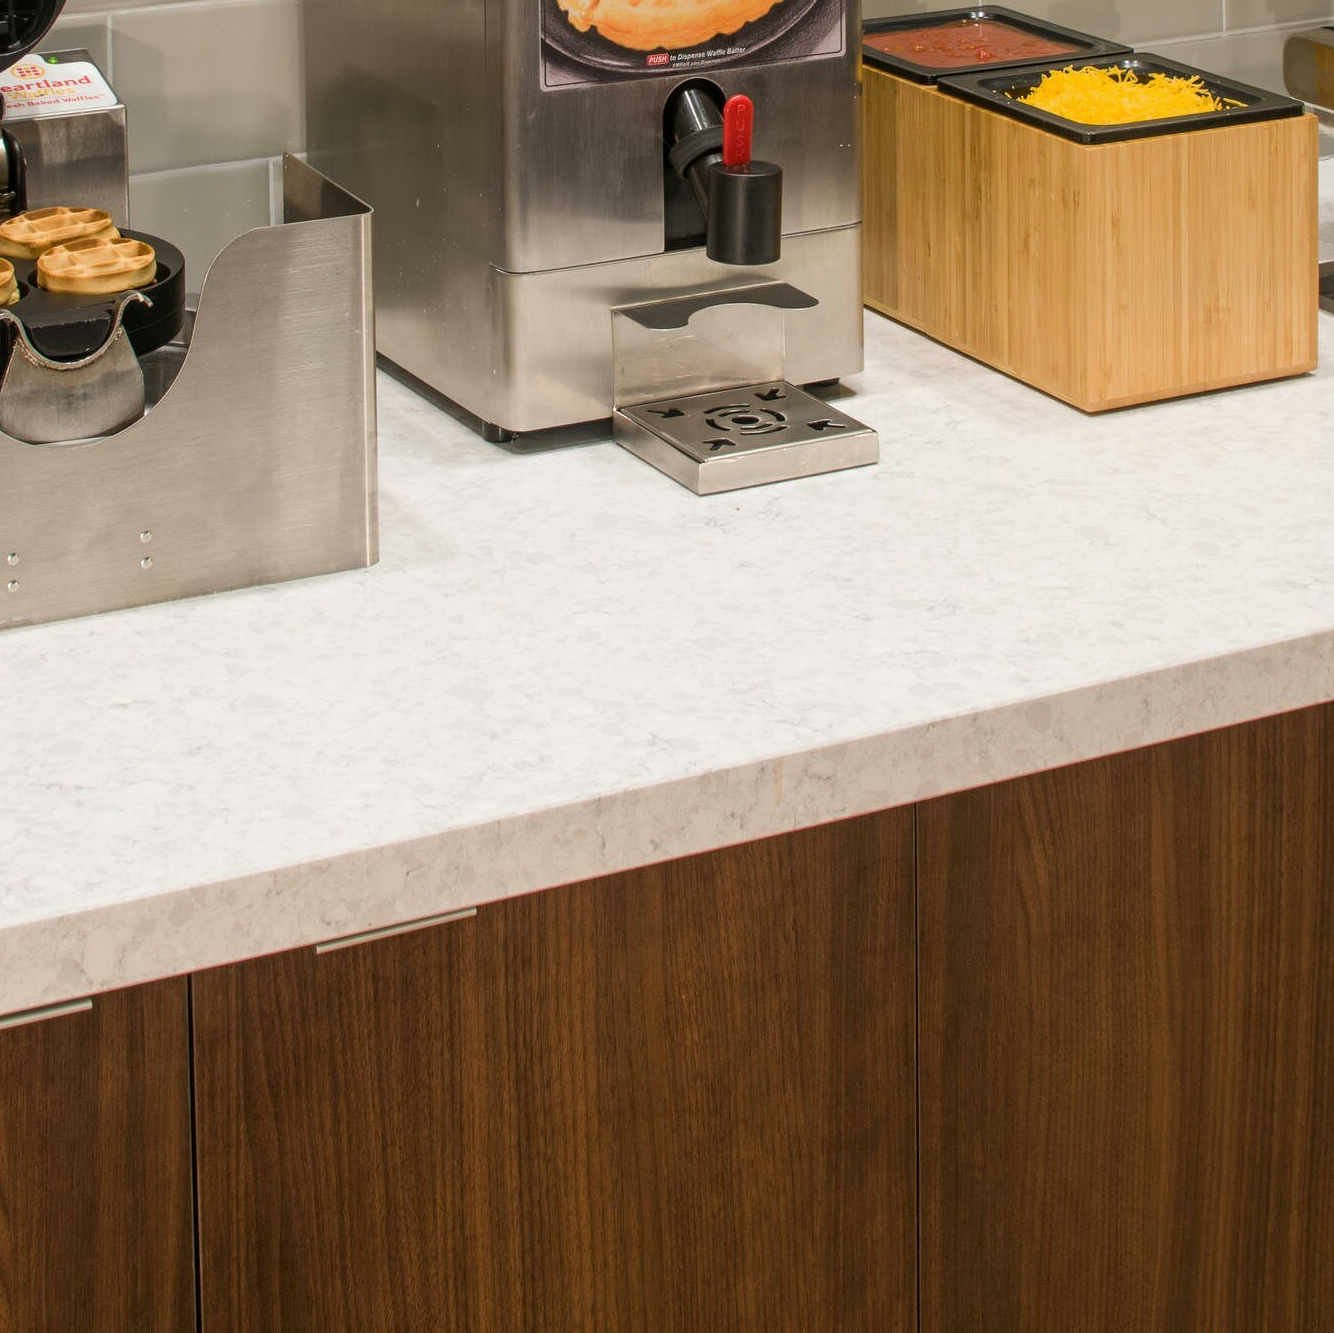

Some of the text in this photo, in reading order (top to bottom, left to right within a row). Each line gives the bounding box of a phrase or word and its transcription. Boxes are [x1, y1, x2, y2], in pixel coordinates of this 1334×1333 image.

[648, 54, 668, 64] PUSH
[670, 54, 677, 62] to
[677, 51, 706, 61] Dispense
[727, 46, 746, 55] Batter
[0, 75, 91, 93] eartland
[8, 87, 76, 100] Waffles
[27, 99, 60, 107] Baked
